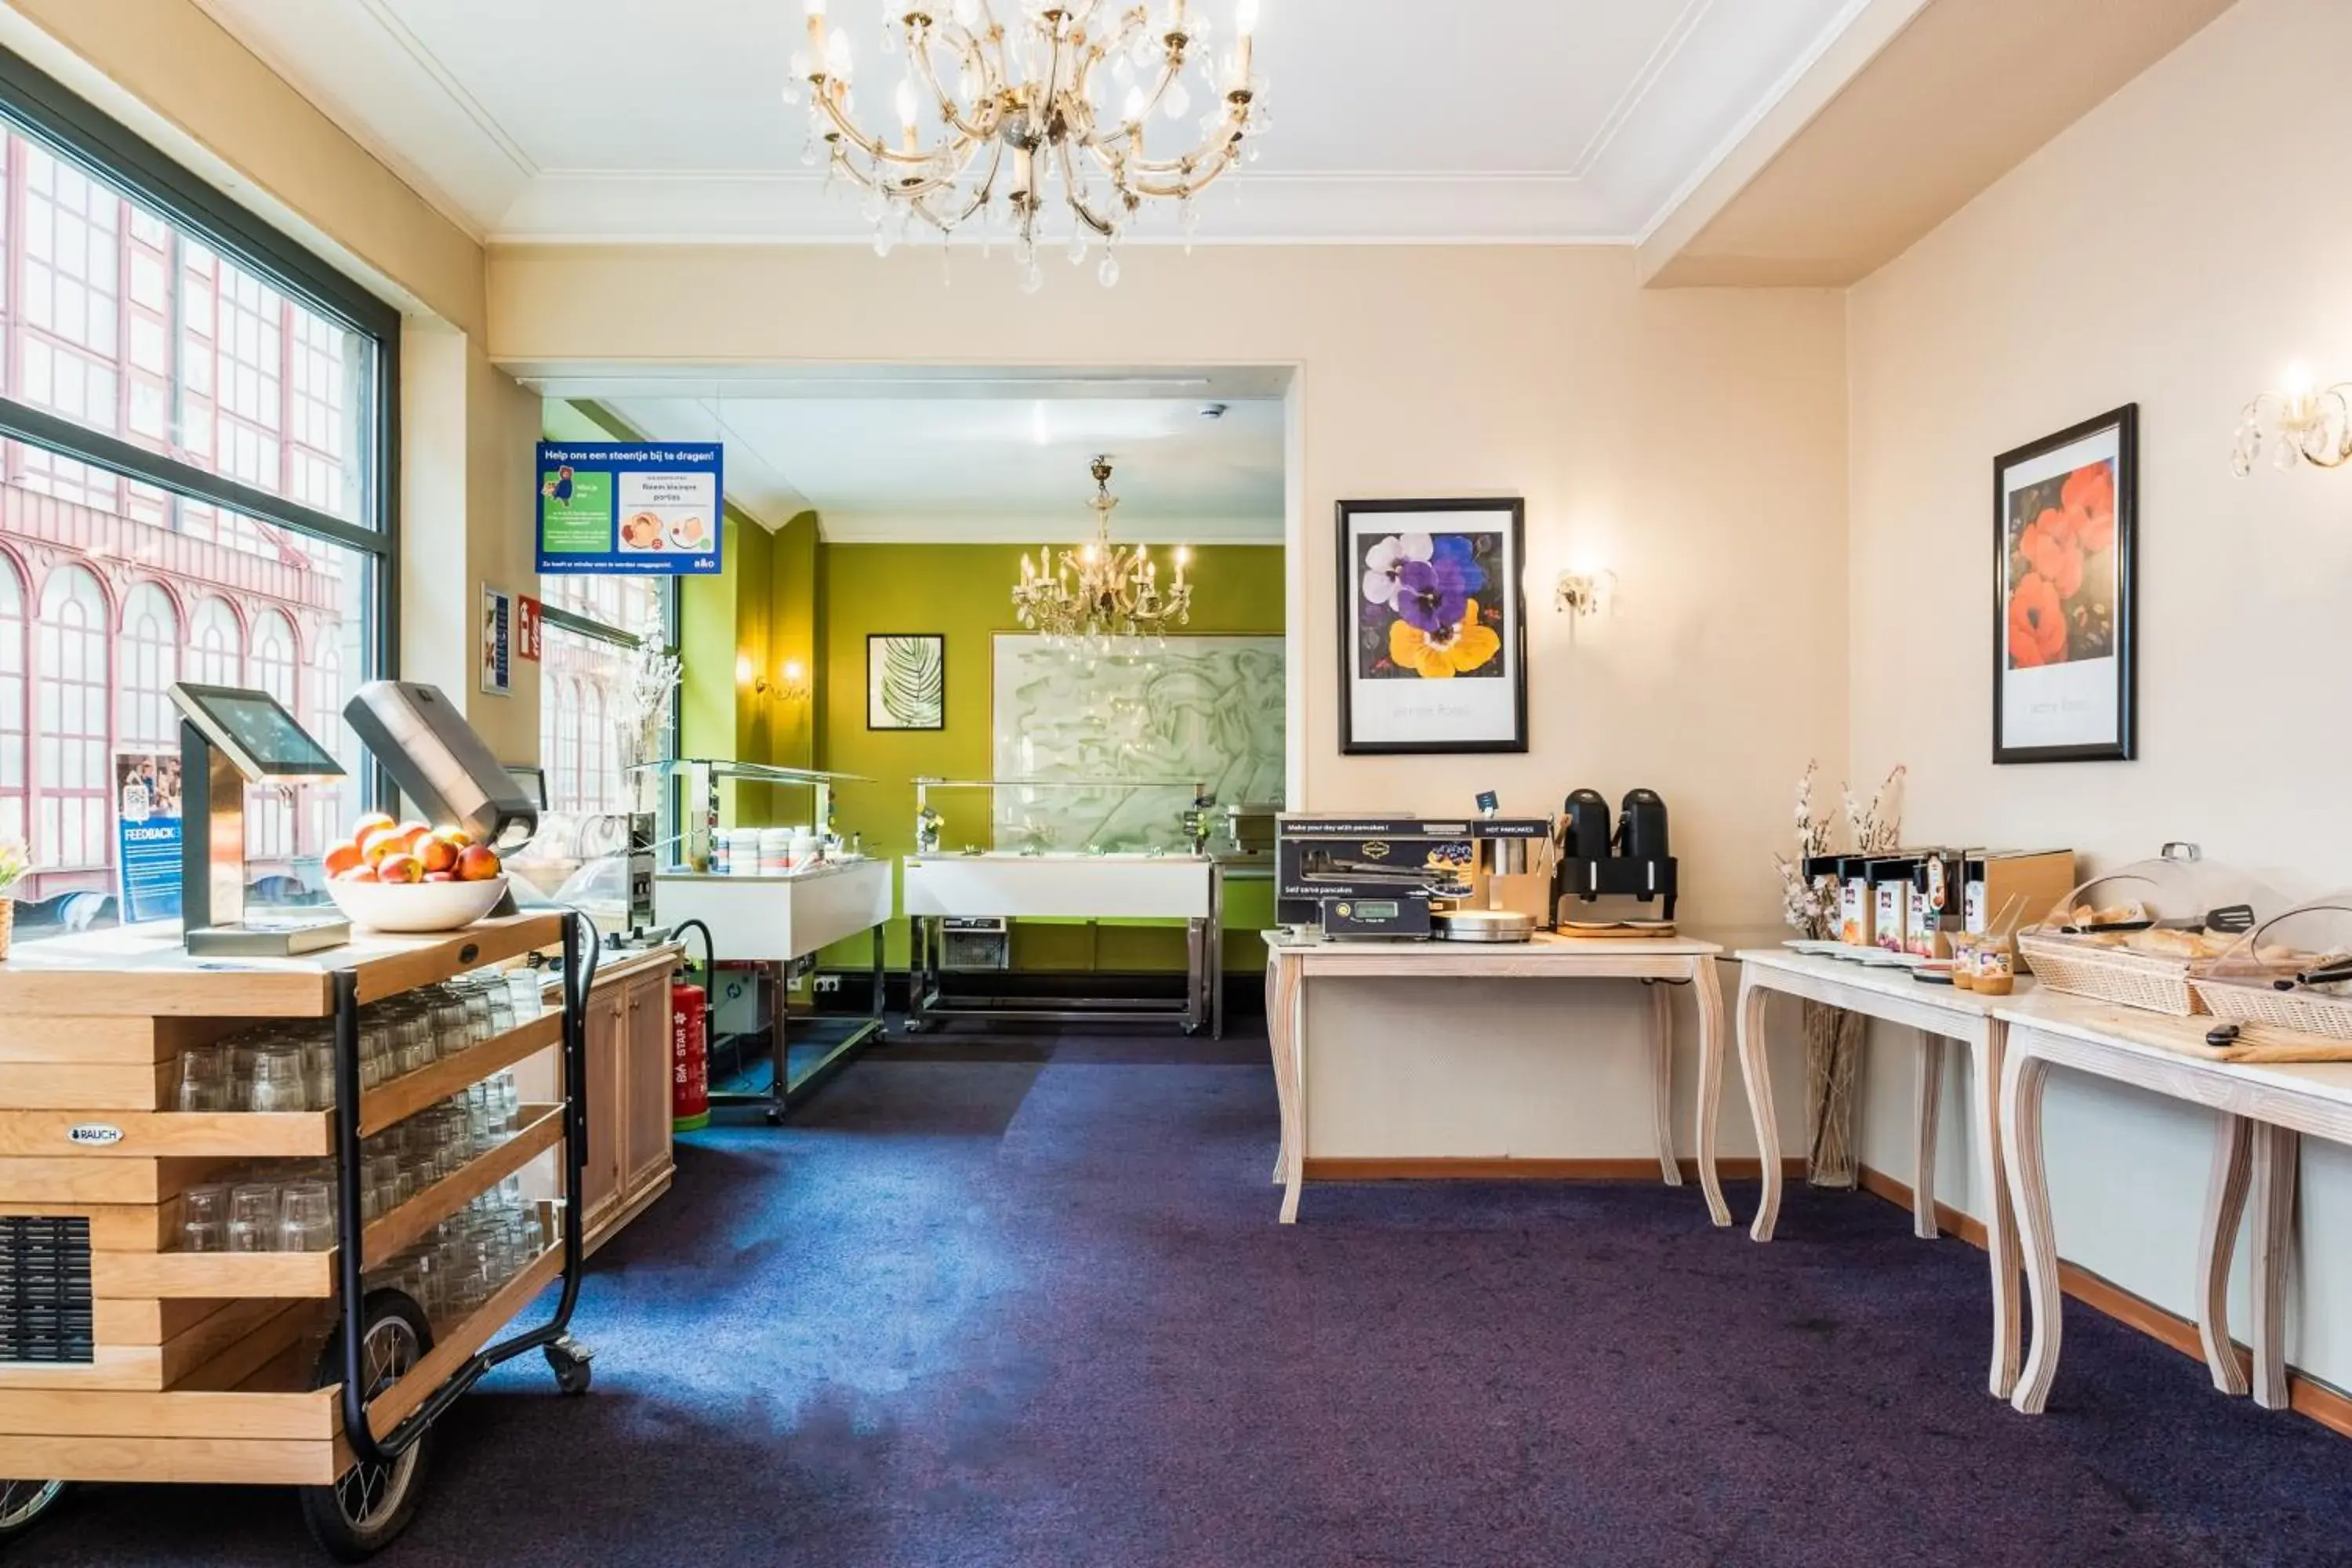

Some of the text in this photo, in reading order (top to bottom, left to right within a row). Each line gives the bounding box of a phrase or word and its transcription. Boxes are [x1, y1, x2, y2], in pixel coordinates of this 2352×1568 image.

[545, 450, 568, 461] Help
[608, 450, 648, 462] steentje
[650, 451, 662, 463] bij
[664, 451, 674, 460] te
[676, 451, 714, 463] dragen!
[125, 827, 174, 841] FEEDBACK
[1319, 886, 1353, 895] pancakes
[677, 1028, 686, 1057] STAR
[81, 1130, 117, 1139] RAUCH
